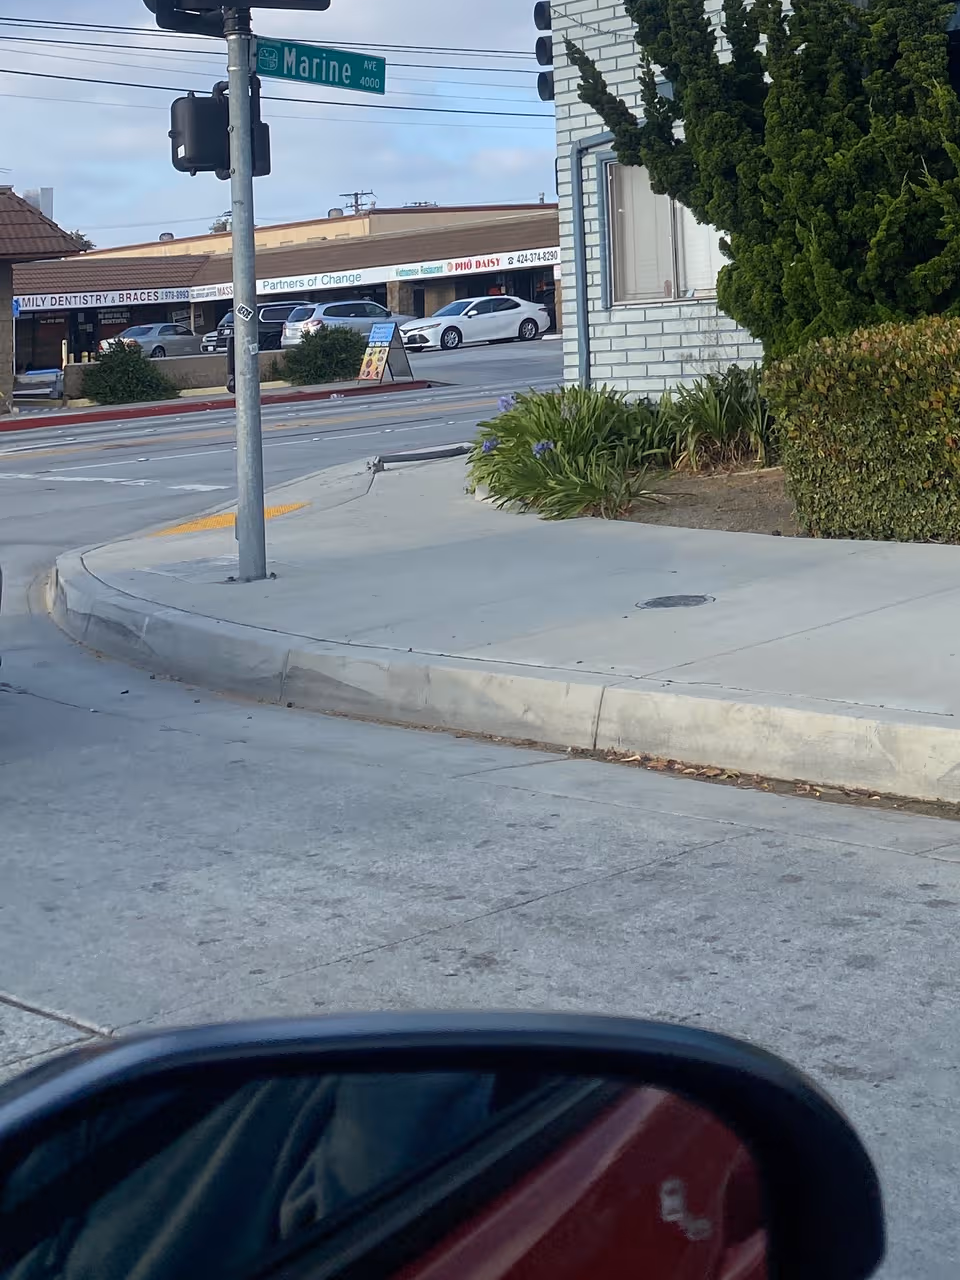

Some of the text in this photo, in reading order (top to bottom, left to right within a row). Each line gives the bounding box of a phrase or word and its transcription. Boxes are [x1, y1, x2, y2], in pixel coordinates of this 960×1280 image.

[283, 46, 352, 84] Marine
[363, 60, 377, 71] AVE
[360, 76, 380, 88] 4000
[475, 257, 501, 269] DAISY
[516, 250, 558, 264] 424-374-8290
[262, 273, 362, 290] Partners of Change
[50, 293, 109, 307] DENTISTRY
[110, 296, 116, 304] &
[118, 291, 159, 303] BRACES
